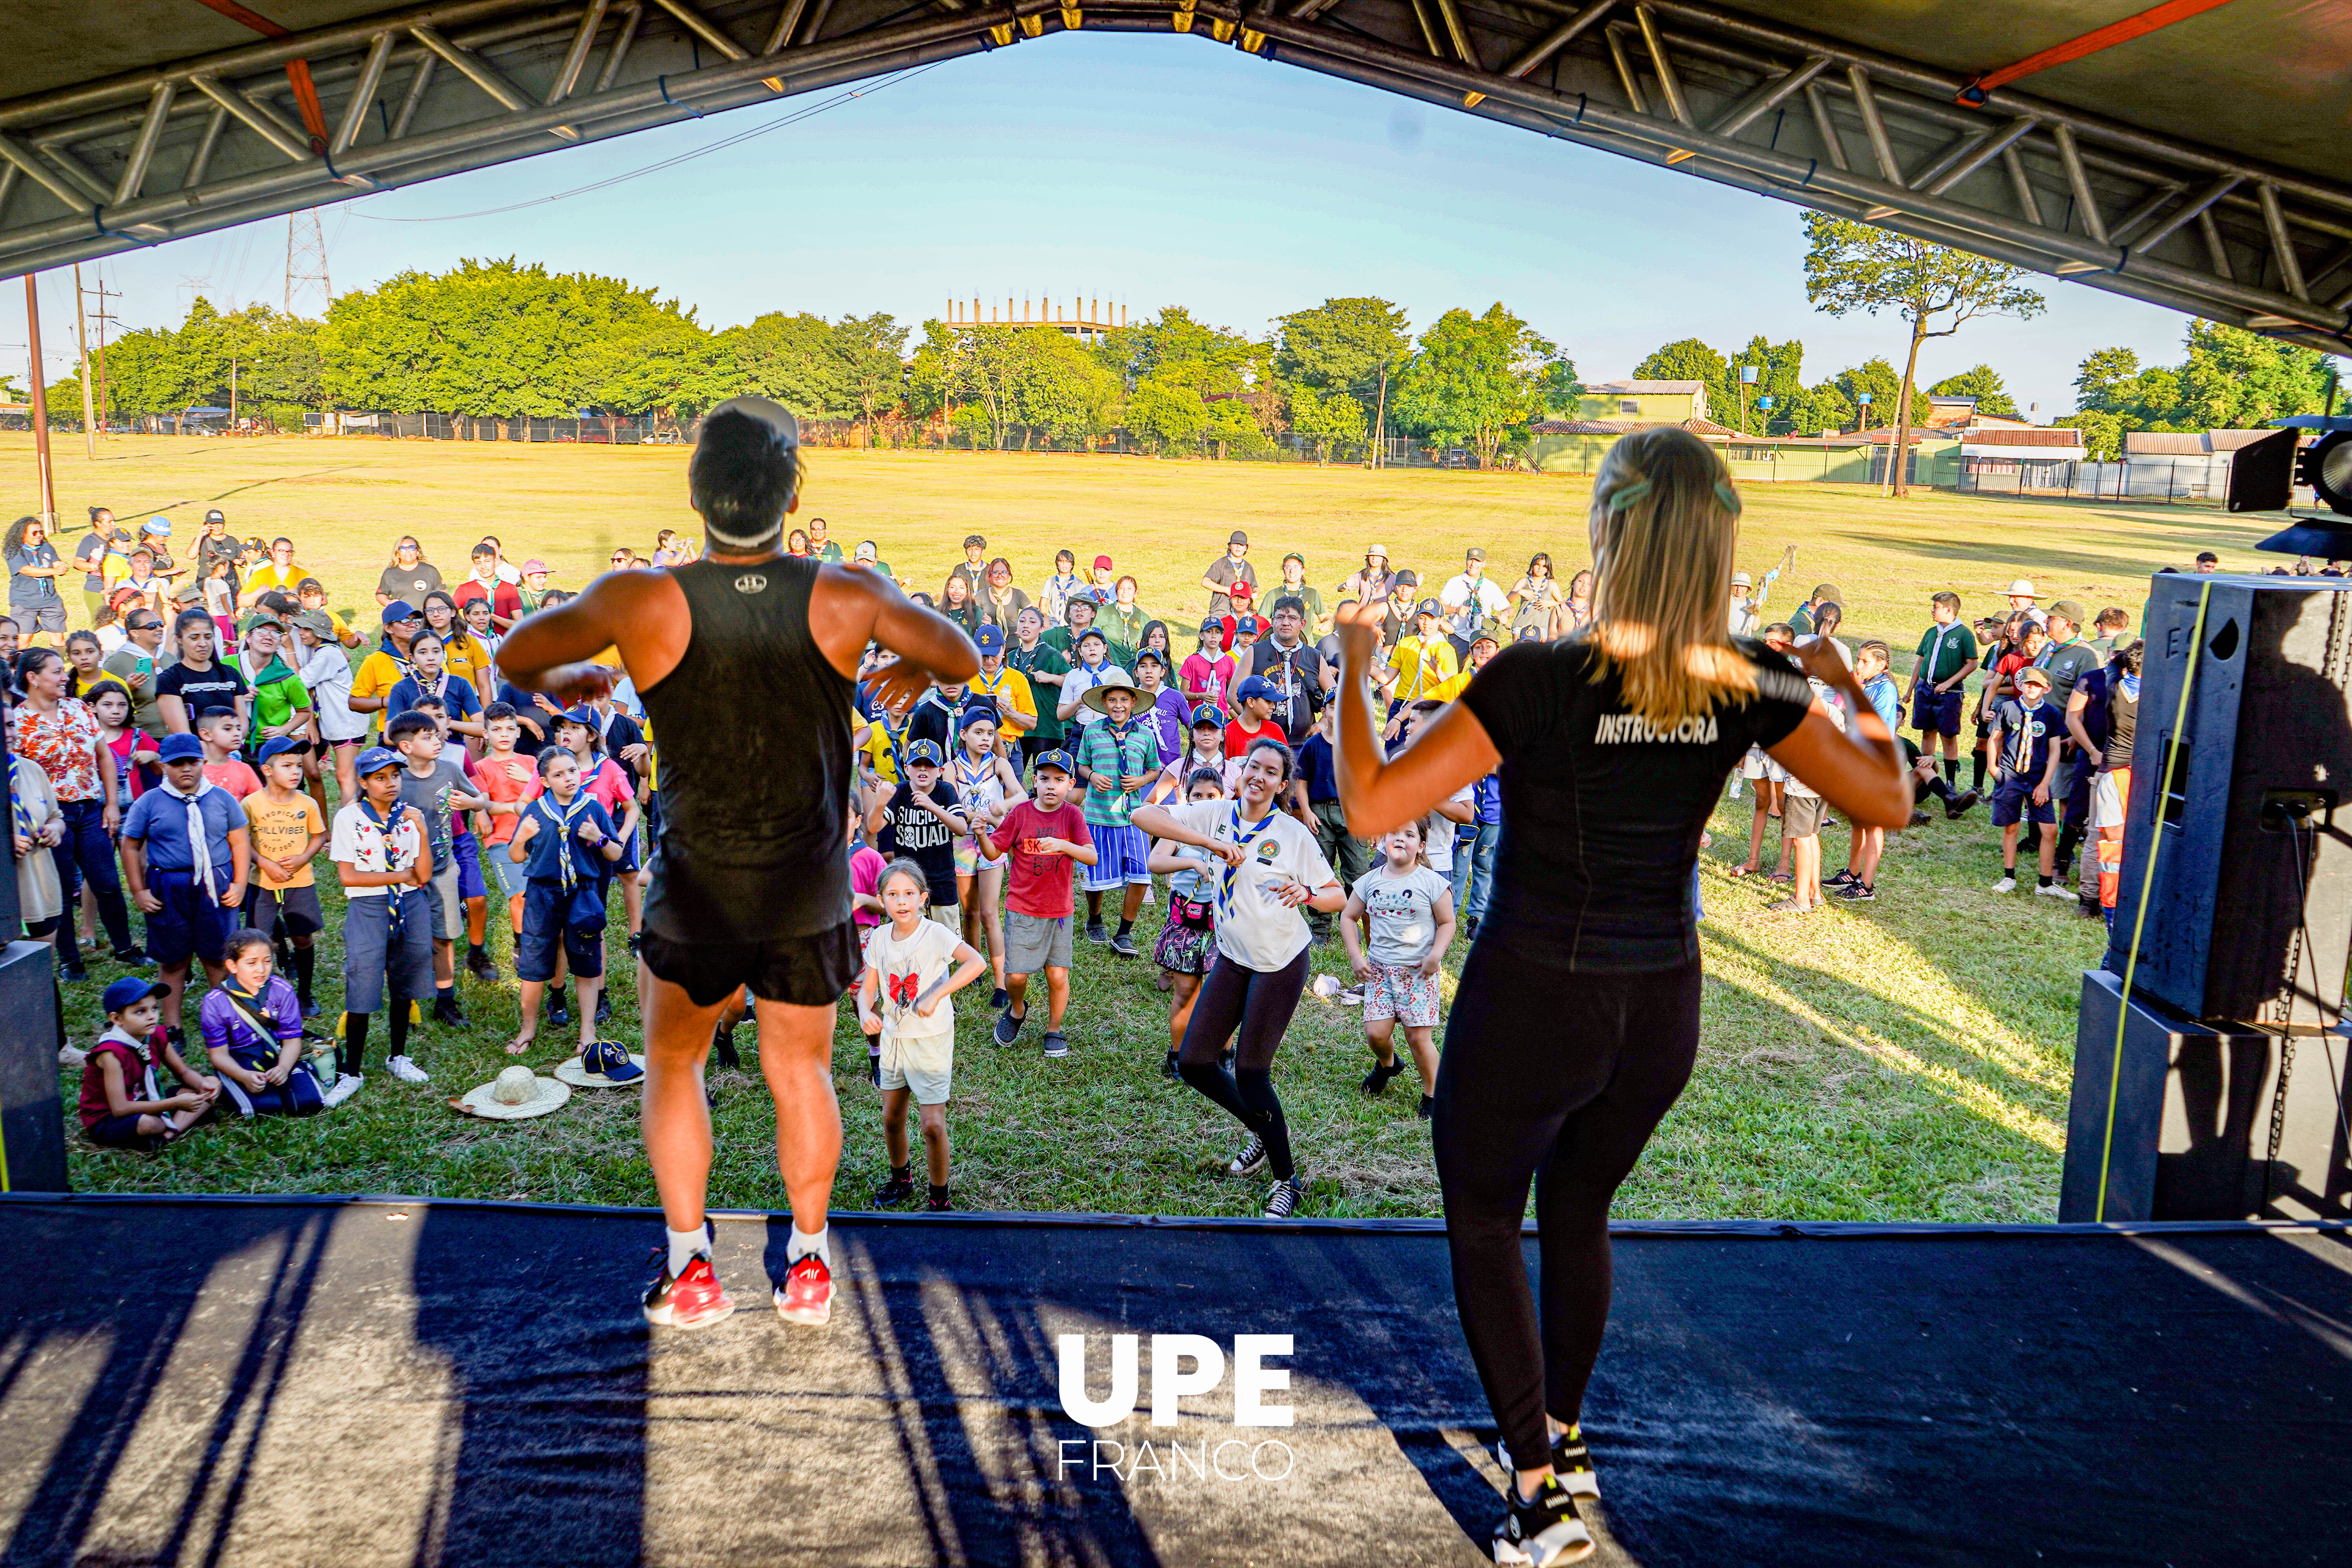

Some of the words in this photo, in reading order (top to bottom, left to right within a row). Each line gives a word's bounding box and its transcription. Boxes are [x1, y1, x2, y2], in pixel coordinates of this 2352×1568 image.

[261, 811, 297, 821] TROPICAL
[897, 805, 945, 825] SUICID
[259, 839, 276, 852] SINCE
[1033, 854, 1064, 877] BOY
